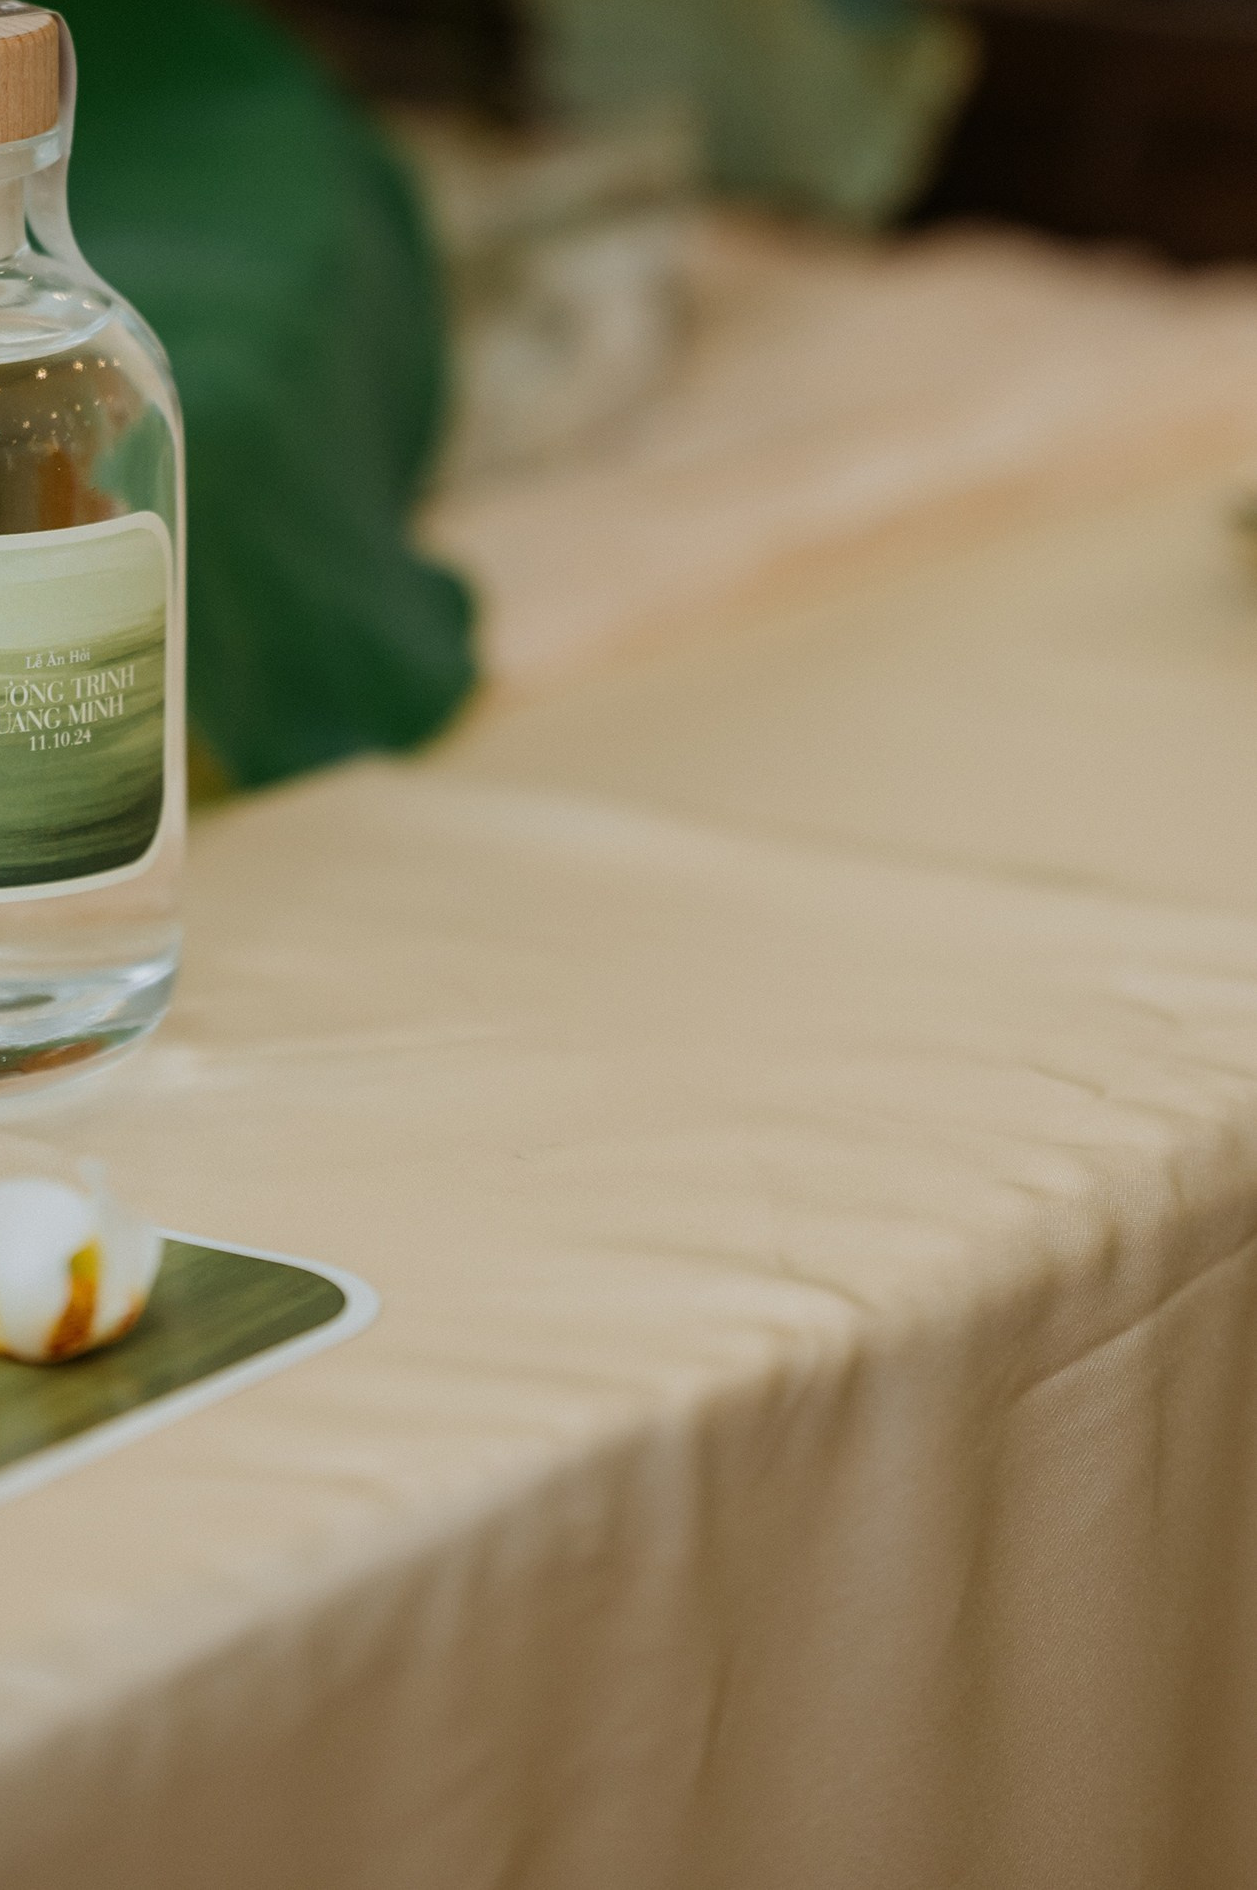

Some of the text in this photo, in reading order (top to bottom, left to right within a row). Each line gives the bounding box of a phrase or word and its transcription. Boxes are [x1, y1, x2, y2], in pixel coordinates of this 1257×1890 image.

[25, 653, 42, 670] Lễ
[46, 650, 65, 667] Ăn
[70, 664, 135, 700] TRINH
[68, 693, 124, 727] MINH
[29, 728, 92, 752] 11.10.24
